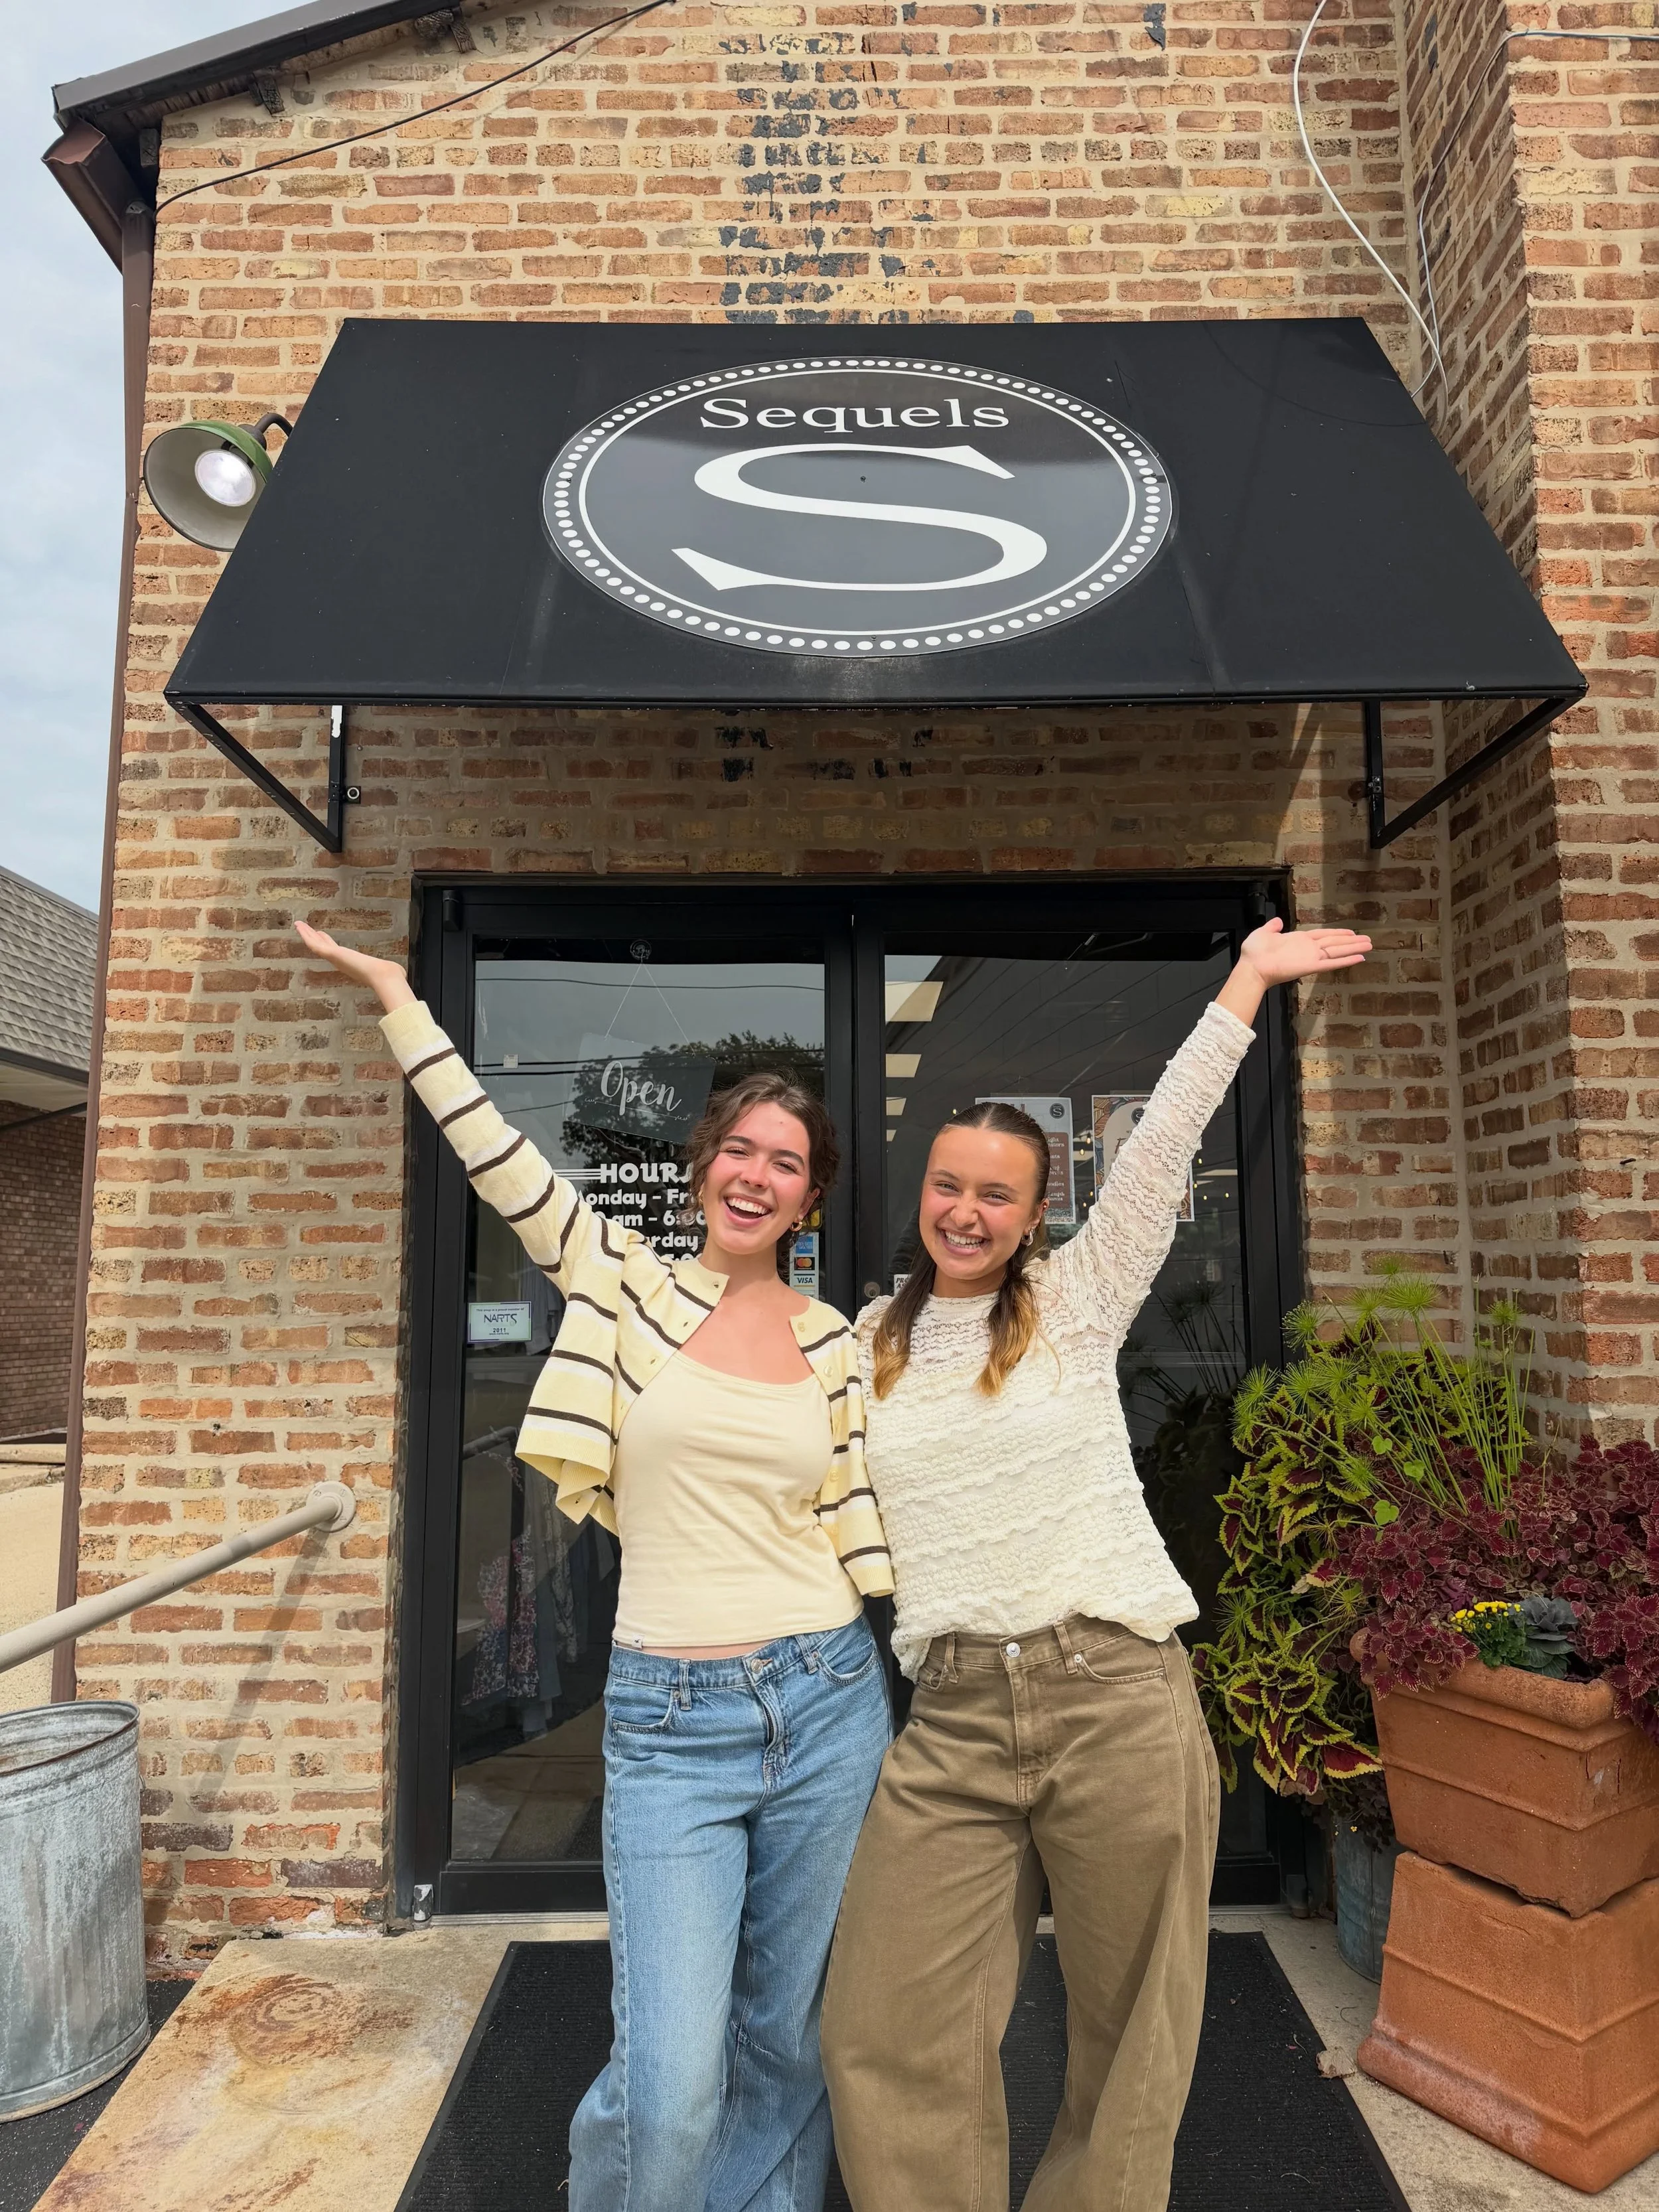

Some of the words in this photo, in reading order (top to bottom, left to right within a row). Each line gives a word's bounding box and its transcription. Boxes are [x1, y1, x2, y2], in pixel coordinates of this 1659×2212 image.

[701, 398, 1009, 433] Sequels
[671, 443, 1047, 591] S
[601, 1061, 682, 1116] Open
[646, 1232, 699, 1252] rday
[484, 1313, 517, 1324] NARTS
